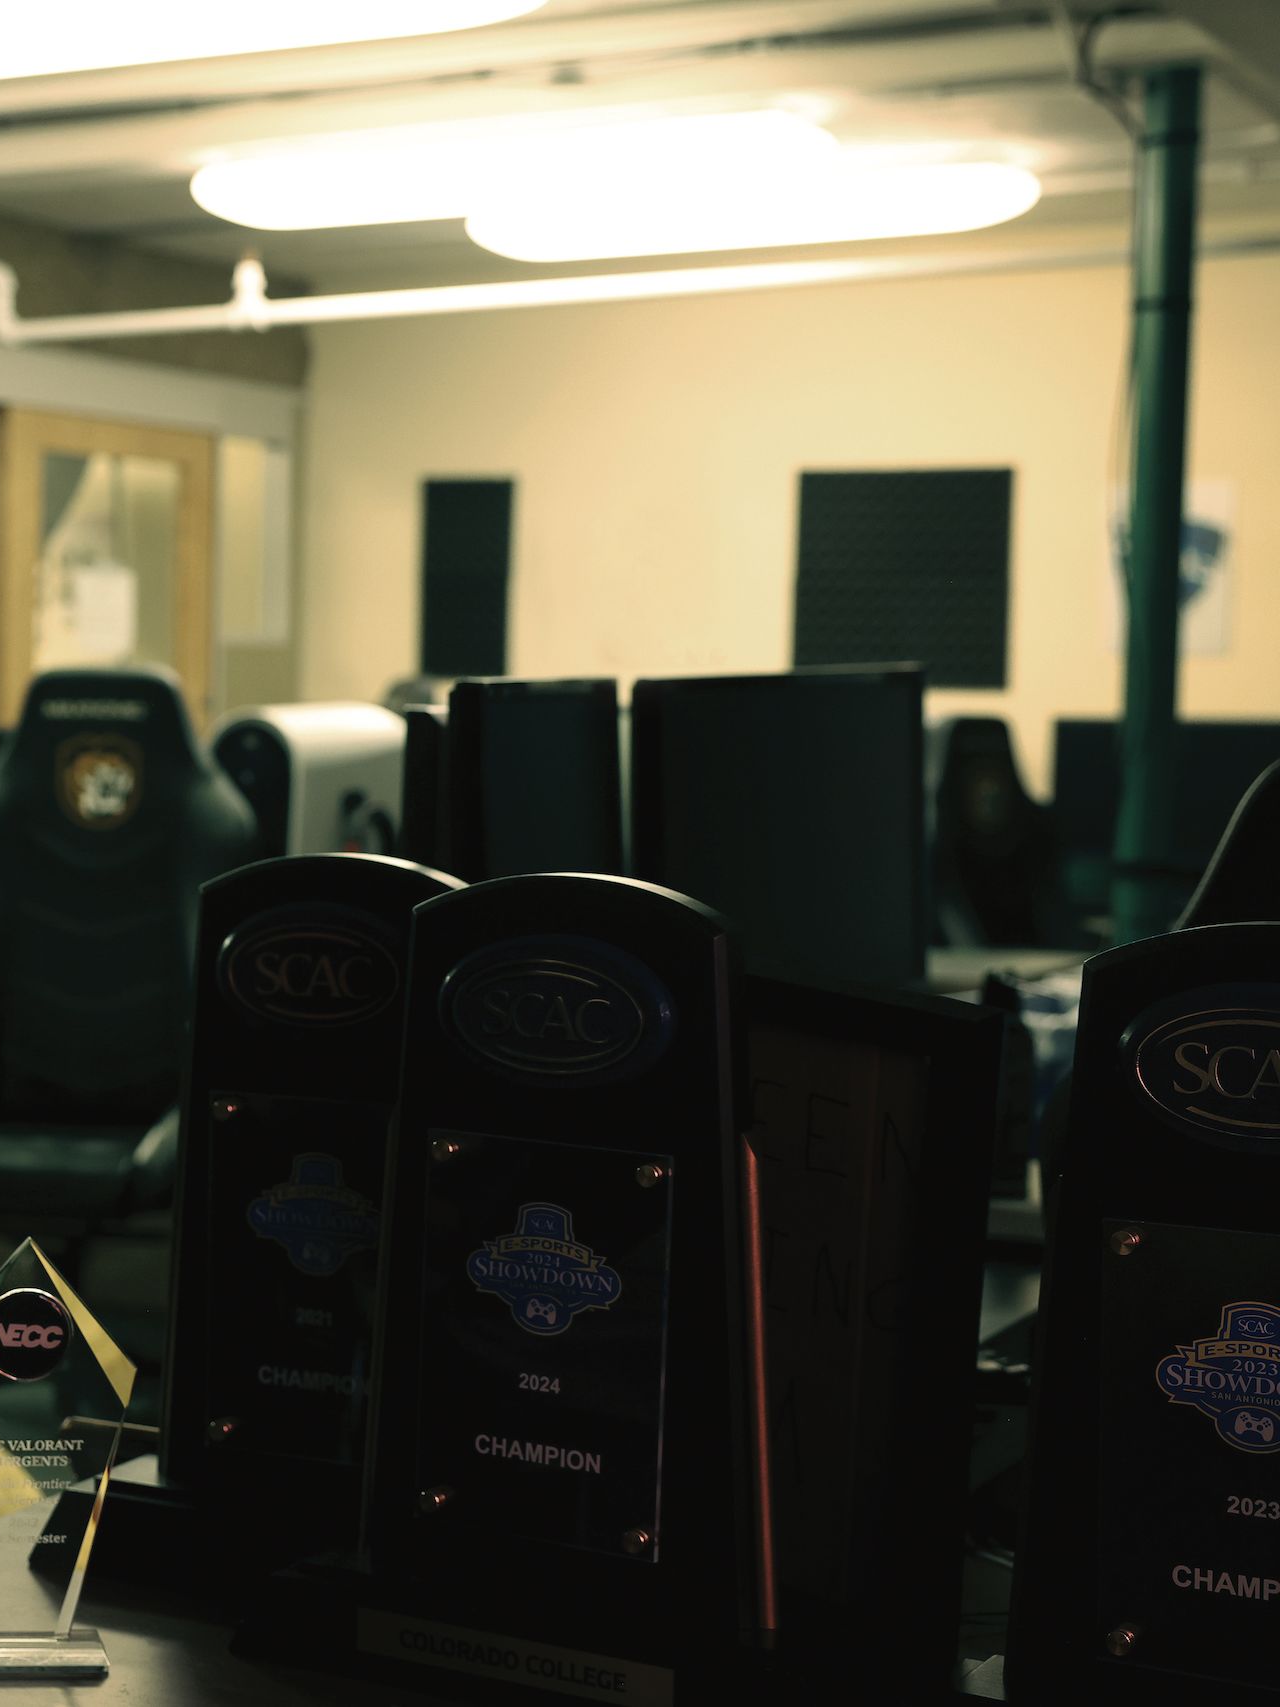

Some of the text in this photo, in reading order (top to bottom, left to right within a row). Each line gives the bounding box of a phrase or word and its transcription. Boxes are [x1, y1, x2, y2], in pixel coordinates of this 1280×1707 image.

[255, 952, 373, 999] SCAC
[481, 990, 611, 1045] SCAC
[1172, 1041, 1280, 1100] SCA
[503, 1238, 585, 1259] E-SPORTS
[526, 1253, 560, 1268] 2024
[474, 1256, 614, 1293] SHOWDOWN
[1238, 1319, 1275, 1335] SCAC
[1204, 1343, 1280, 1359] E-SPOR
[1166, 1364, 1280, 1396] SHOWD
[1232, 1359, 1279, 1376] 2023
[518, 1373, 562, 1396] 2024
[1211, 1392, 1232, 1401] SAN
[8, 1439, 85, 1451] VALORANT
[474, 1433, 602, 1475] CHAMPION
[1226, 1495, 1280, 1520] 2023
[1172, 1563, 1280, 1601] CHAMP
[399, 1629, 628, 1693] COLORADO COLLEGE
